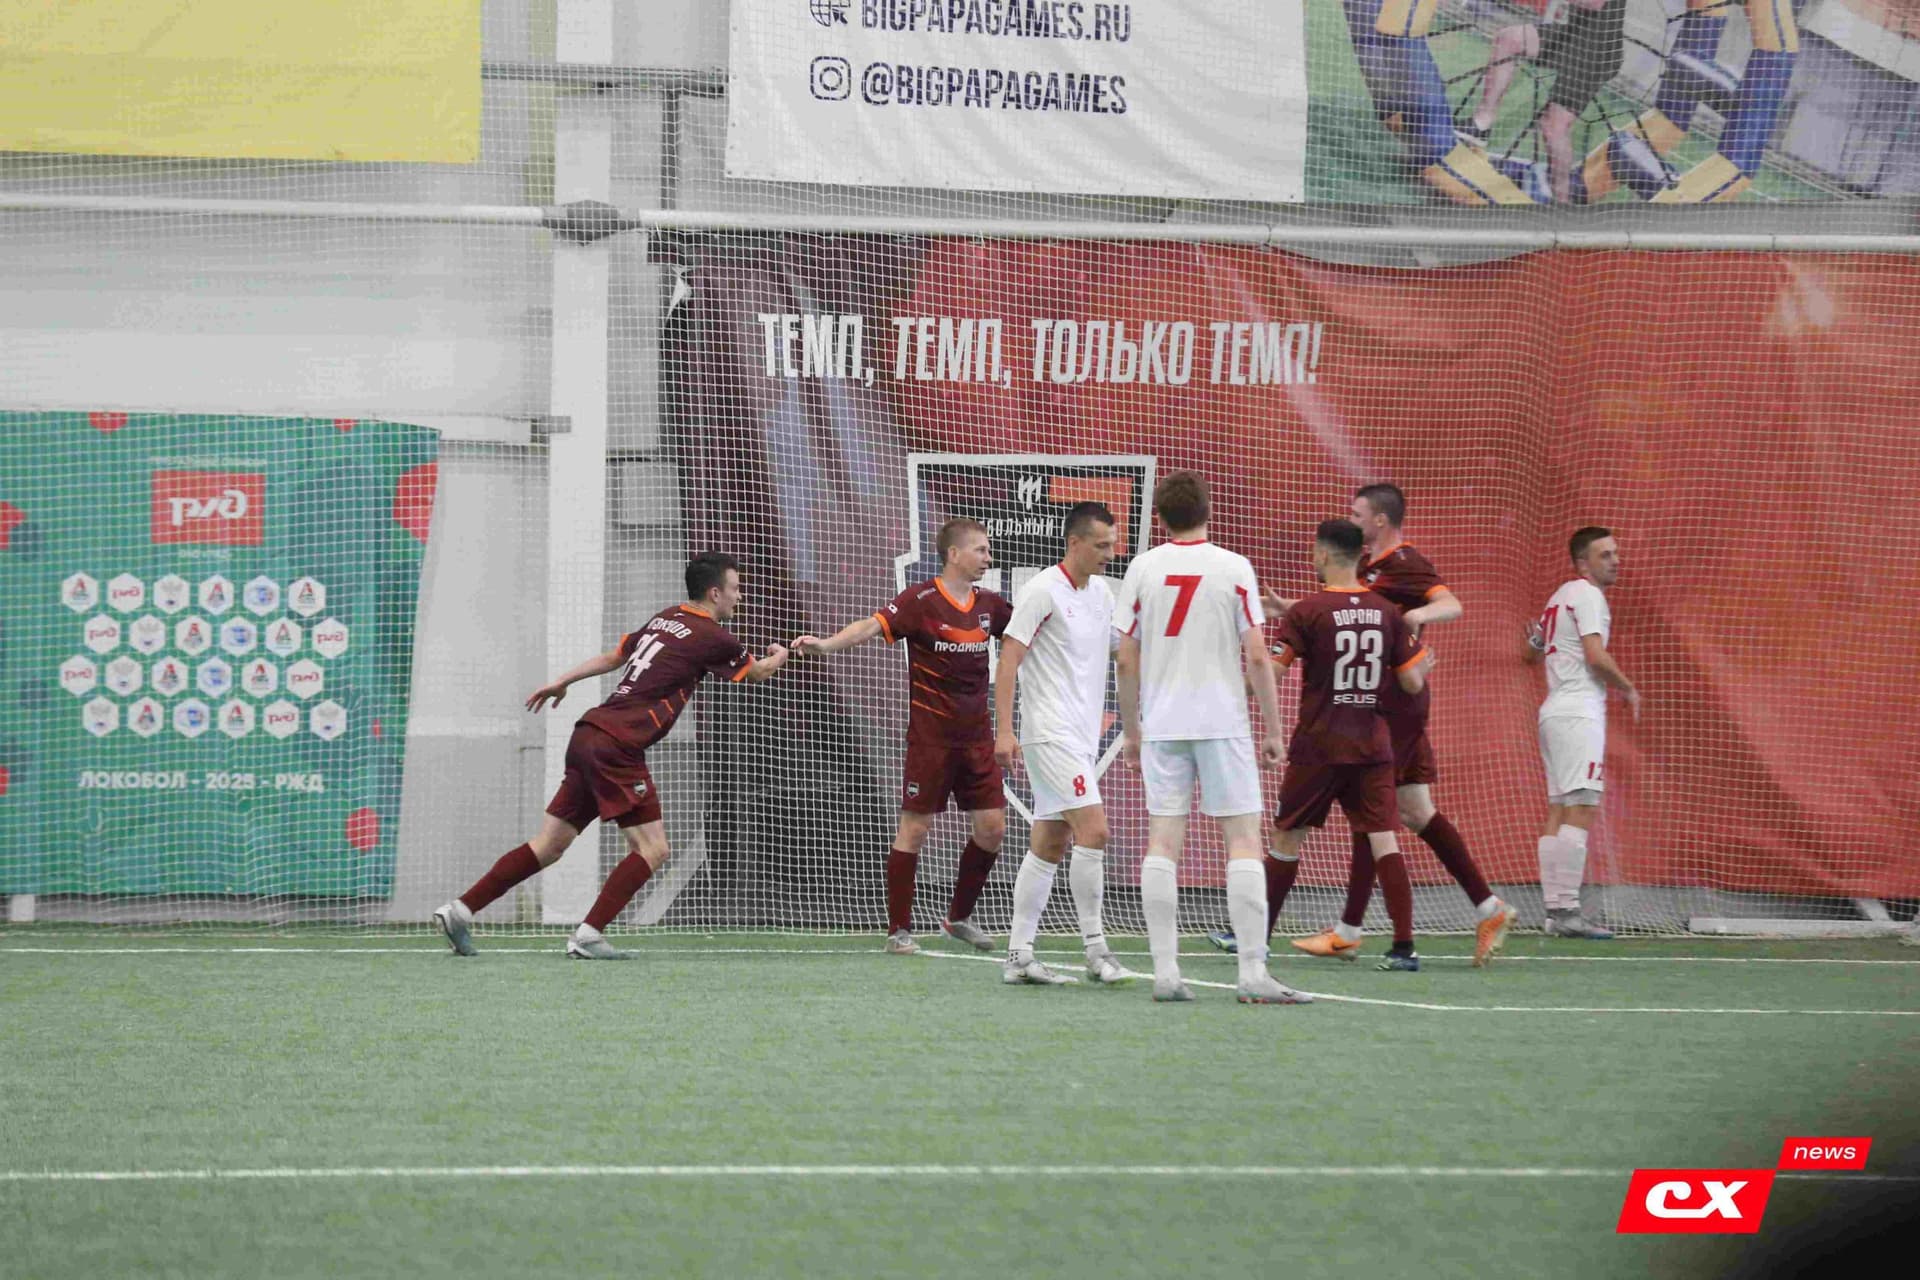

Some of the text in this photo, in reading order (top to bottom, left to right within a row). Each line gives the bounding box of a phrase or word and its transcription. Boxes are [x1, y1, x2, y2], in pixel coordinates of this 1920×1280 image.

[862, 0, 1131, 42] BIGPAPAGAMES.RU
[861, 62, 1127, 114] @BIGPAPAGAMES
[758, 313, 1323, 389] ТЕМП, ТЕМП, ТОЛЬКО ТЕМП!
[1163, 574, 1203, 637] 7
[1333, 629, 1383, 691] 23
[1333, 693, 1377, 704] SEUS
[78, 771, 187, 789] ЛОКОБОЛ
[205, 773, 255, 790] 2025
[275, 773, 325, 793] РЖД
[1073, 774, 1087, 797] 8
